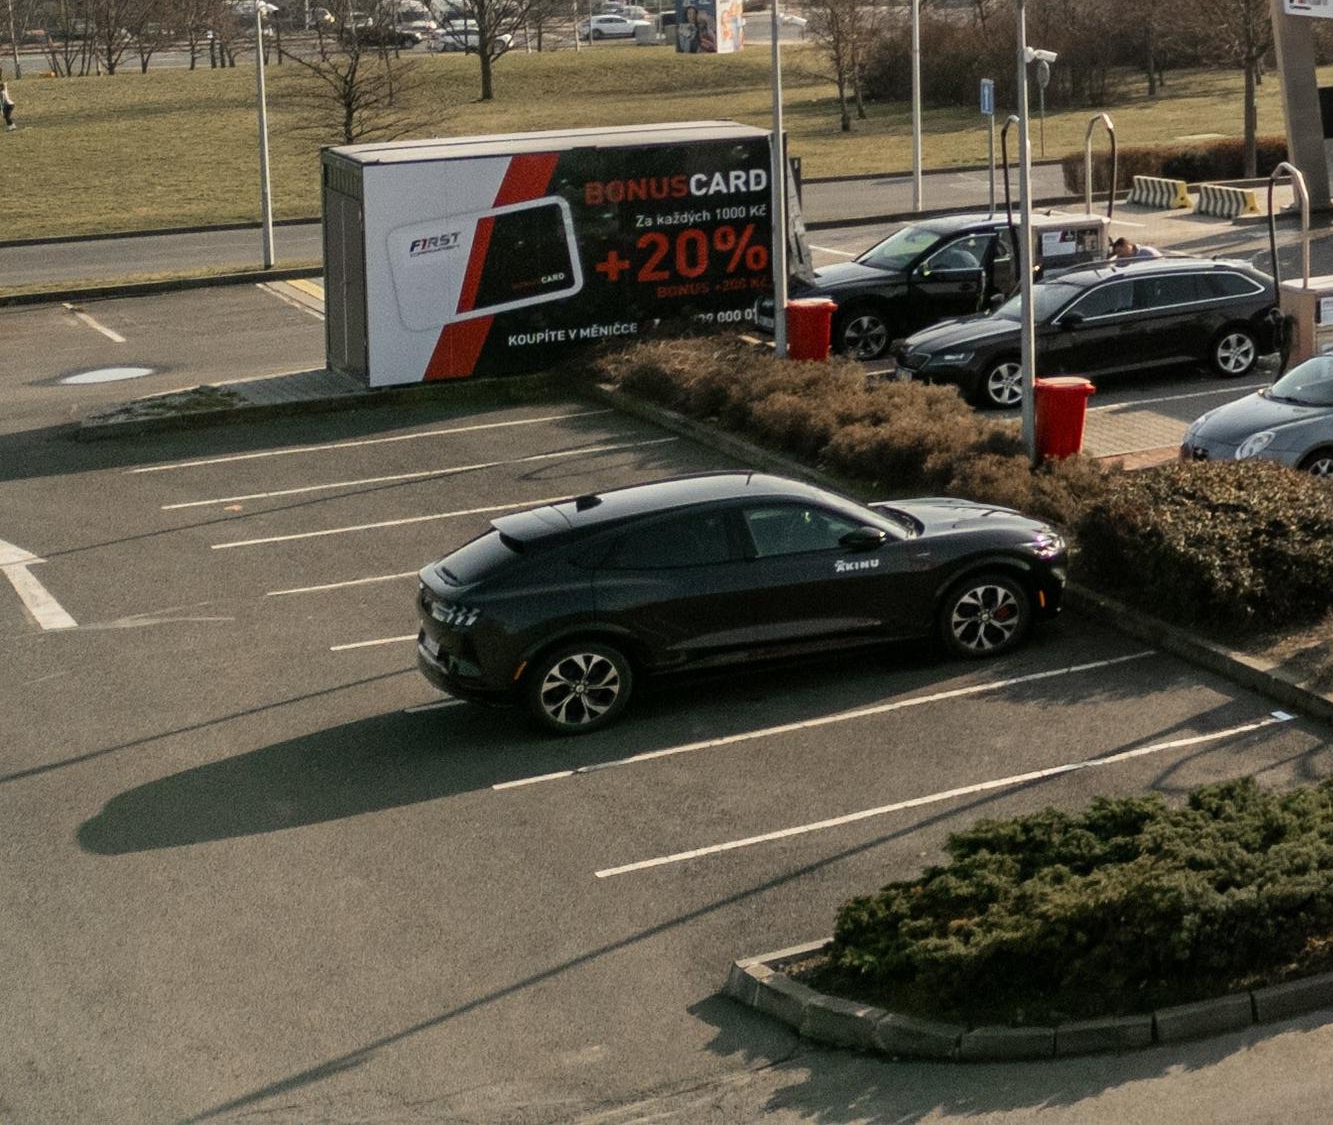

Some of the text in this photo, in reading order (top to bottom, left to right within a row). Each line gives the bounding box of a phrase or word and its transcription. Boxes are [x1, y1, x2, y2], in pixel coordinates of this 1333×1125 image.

[636, 204, 767, 228] Za každých 1000 Kč
[595, 223, 769, 284] +20%
[656, 282, 709, 299] BONUS
[507, 321, 638, 347] KOUPÍTE V MĚNIČCE
